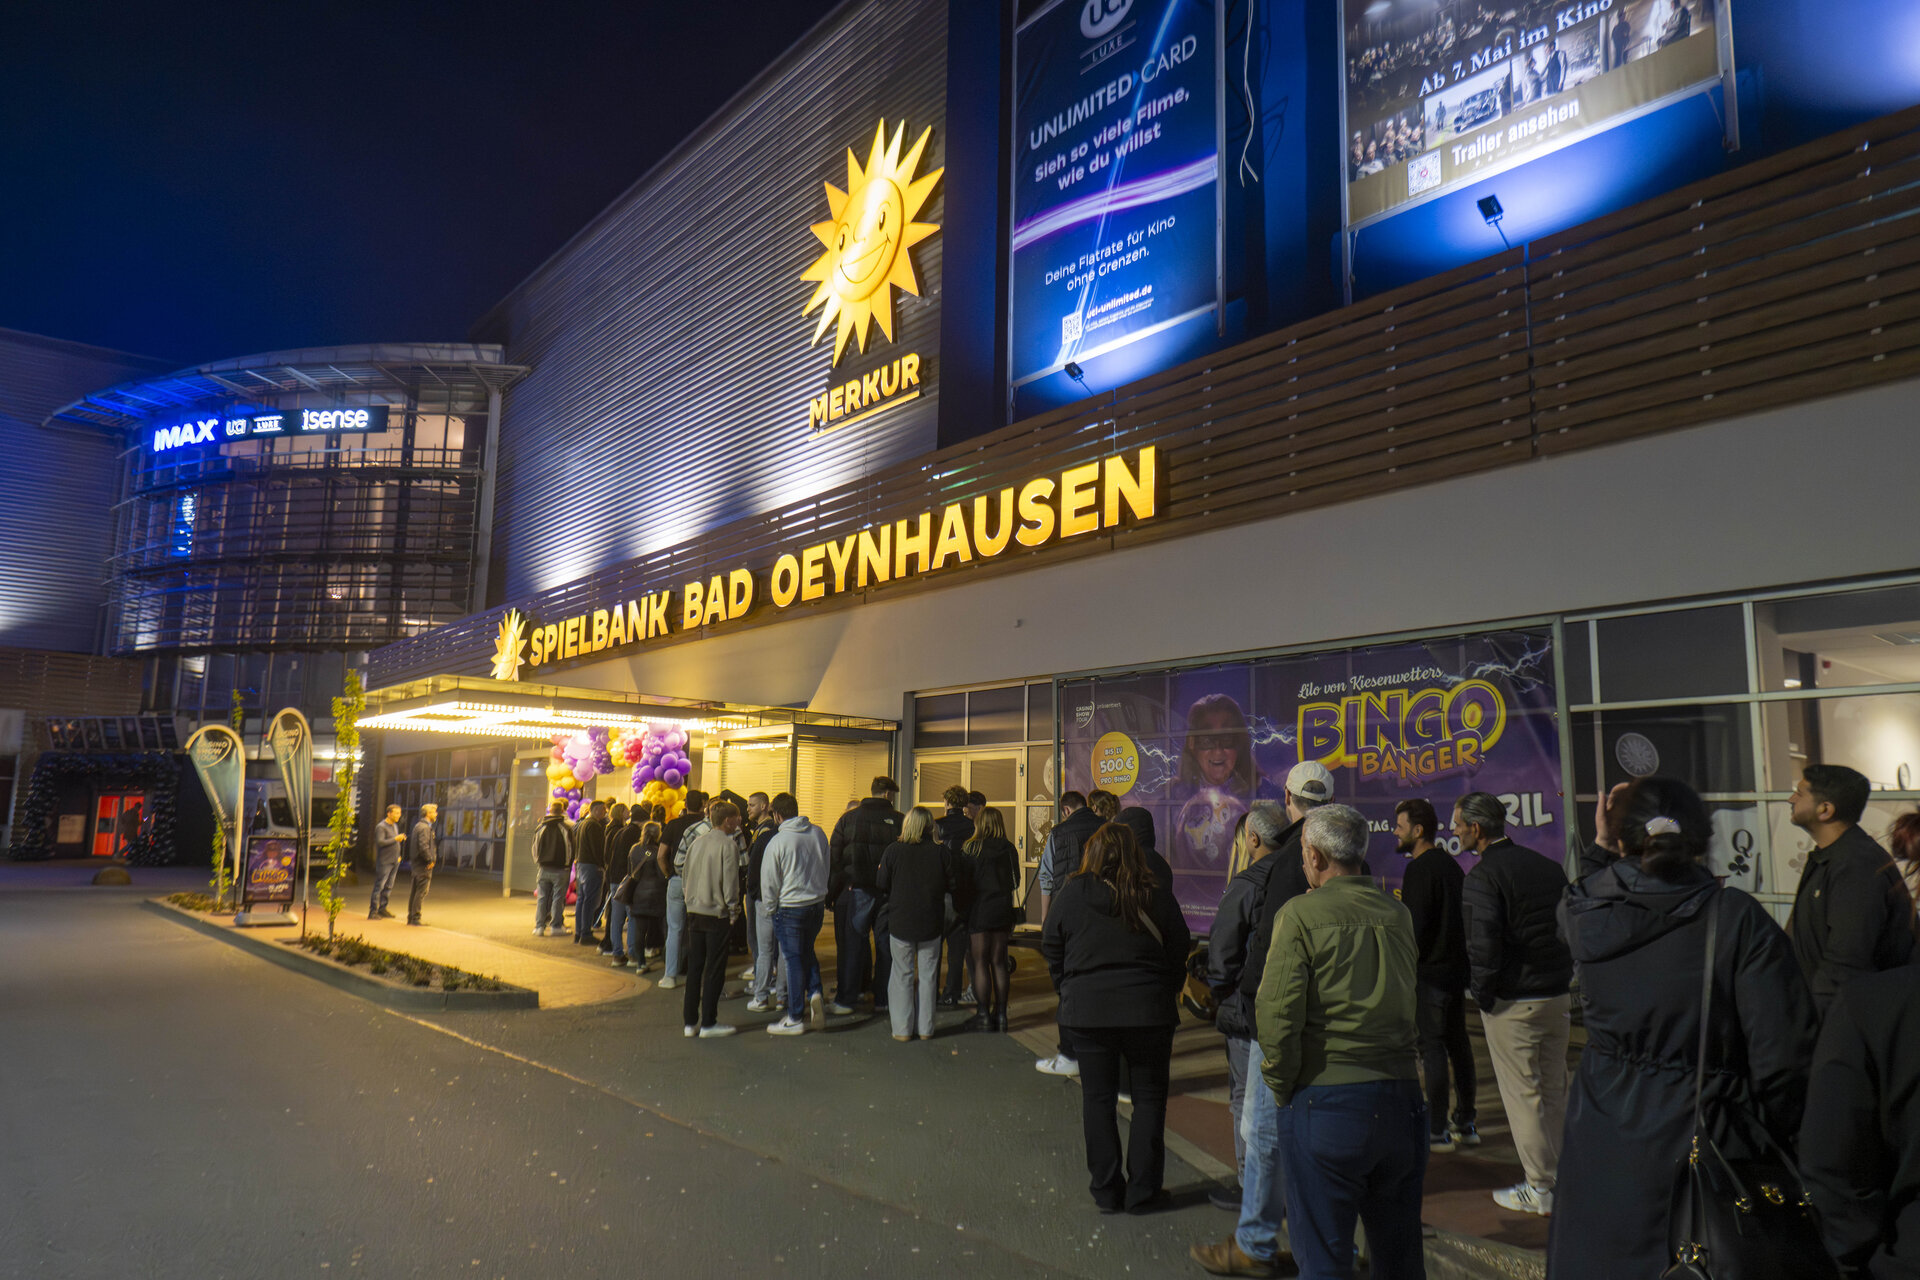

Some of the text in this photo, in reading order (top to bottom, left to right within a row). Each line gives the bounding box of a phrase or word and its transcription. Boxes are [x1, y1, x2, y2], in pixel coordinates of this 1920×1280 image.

[1092, 34, 1123, 63] LUXE
[1418, 0, 1613, 98] Ab 7. Mai im Kino
[1030, 34, 1197, 150] UNLIMITED CARD
[1034, 86, 1190, 182] Sieh so viele Filme,
[1452, 130, 1503, 166] Trailer
[1508, 98, 1580, 143] ansehen
[1057, 120, 1161, 191] wie du willst
[1045, 215, 1176, 286] Deine Flatrate für Kino
[1067, 246, 1150, 291] ohne Grenzen.
[1087, 284, 1153, 319] uci-unlimited.de
[809, 353, 920, 428] MERKUR
[154, 418, 218, 452] IMAX
[225, 418, 247, 436] UCI
[530, 445, 1156, 666] SPIELBANK BAD OEYNHAUSEN
[1298, 667, 1444, 699] Lilo von Kiesenwetters
[1298, 679, 1506, 769] BINGO
[1104, 748, 1114, 756] BIS
[1361, 736, 1480, 780] BANGER
[1100, 775, 1131, 785] PRO BINGO
[1731, 829, 1754, 859] Q
